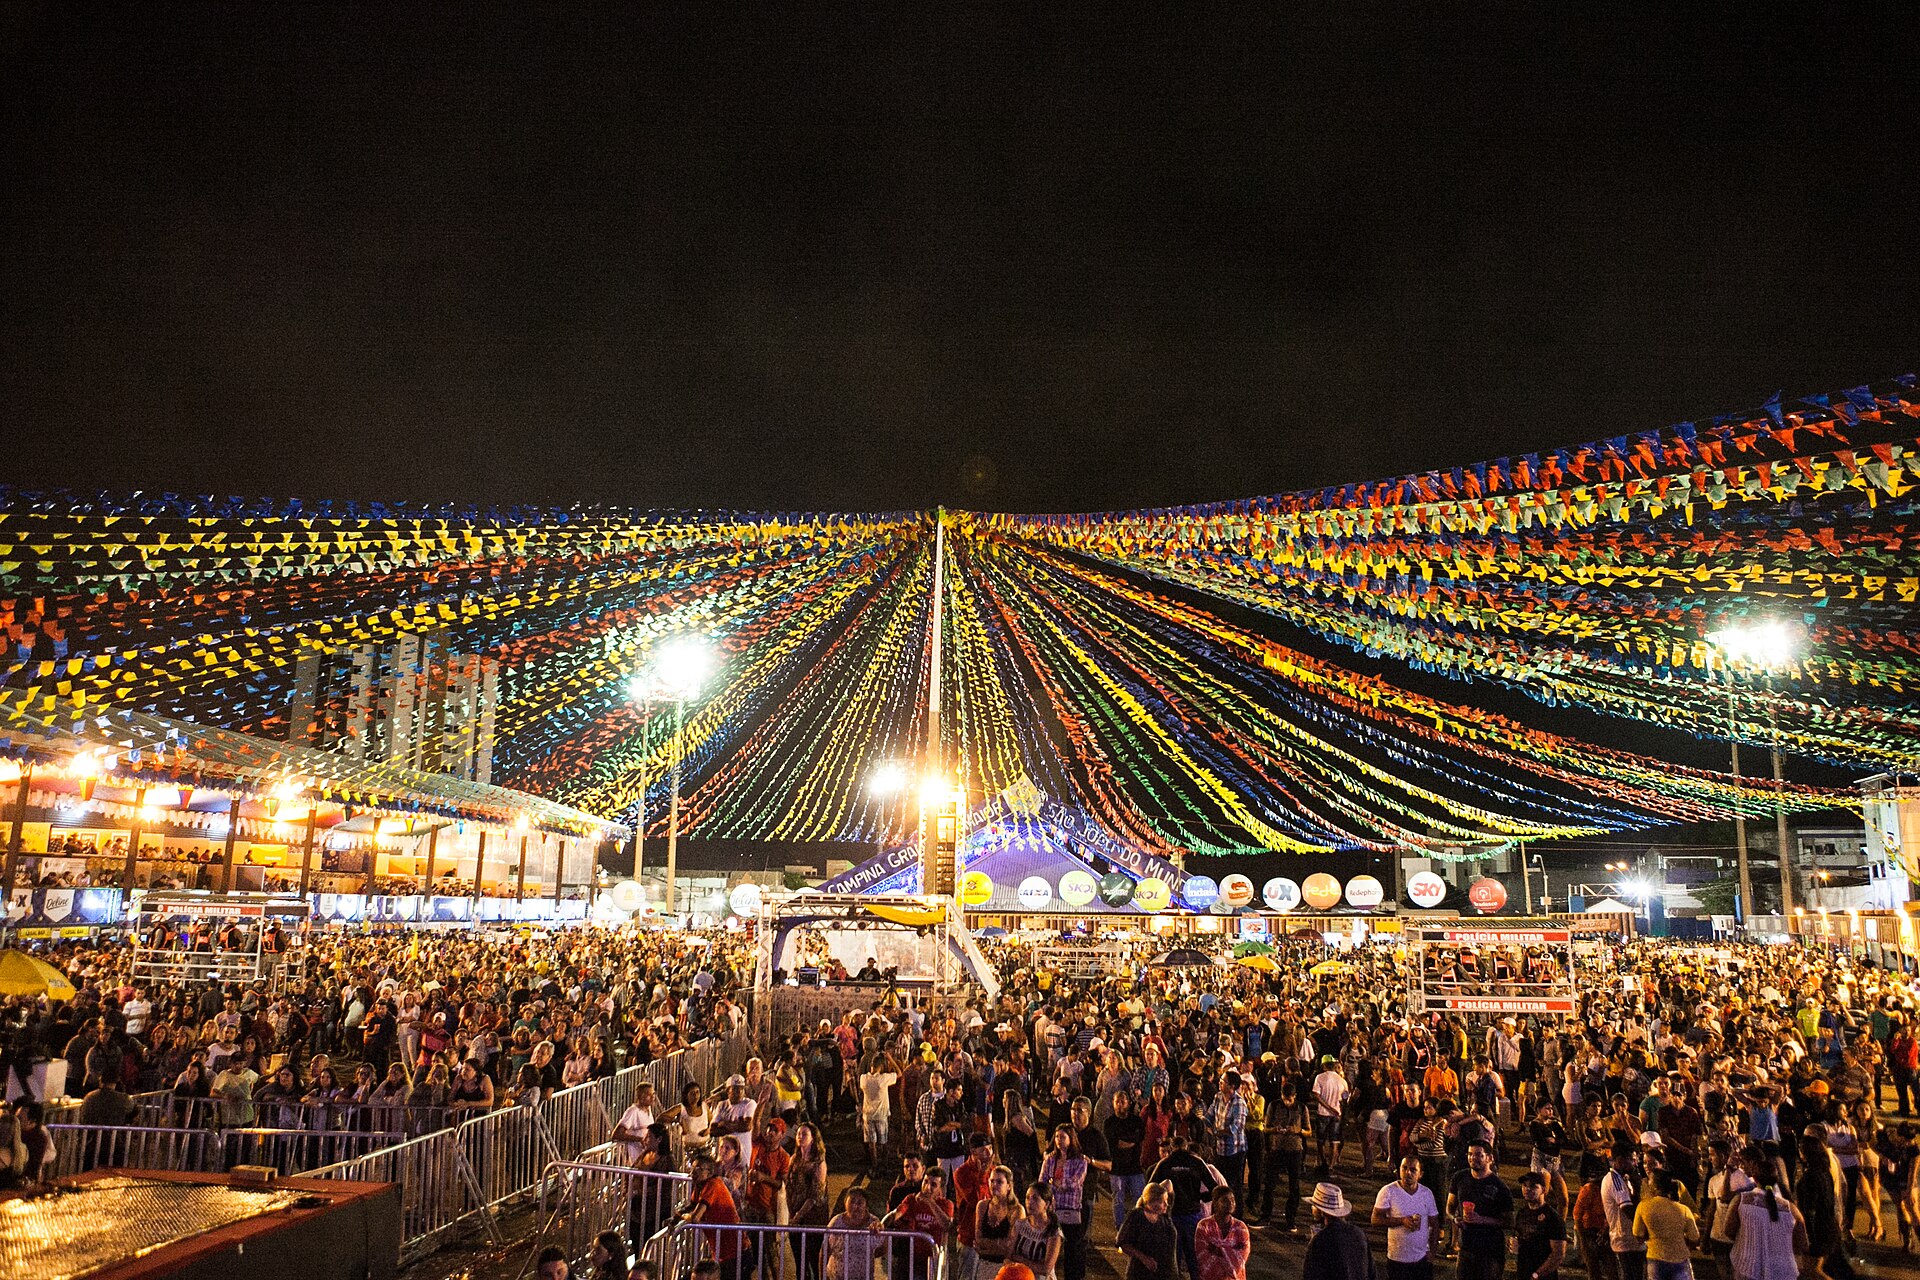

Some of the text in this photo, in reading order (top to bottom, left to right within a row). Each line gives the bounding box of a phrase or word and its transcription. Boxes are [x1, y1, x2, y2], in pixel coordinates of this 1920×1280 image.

[1045, 801, 1075, 829] SÃO
[1119, 848, 1142, 867] DO
[828, 843, 919, 894] CAMPINA GRA
[1067, 882, 1094, 893] SKOL
[1305, 884, 1340, 898] rede
[1412, 883, 1442, 897] SKY
[1019, 889, 1049, 897] CAIXA
[1134, 890, 1159, 900] SKOL
[167, 905, 242, 915] POLÍCIA MILITAR
[1455, 932, 1544, 942] POLÍCIA MILITAR
[1458, 1000, 1547, 1010] POLÍCIA MILITAR
